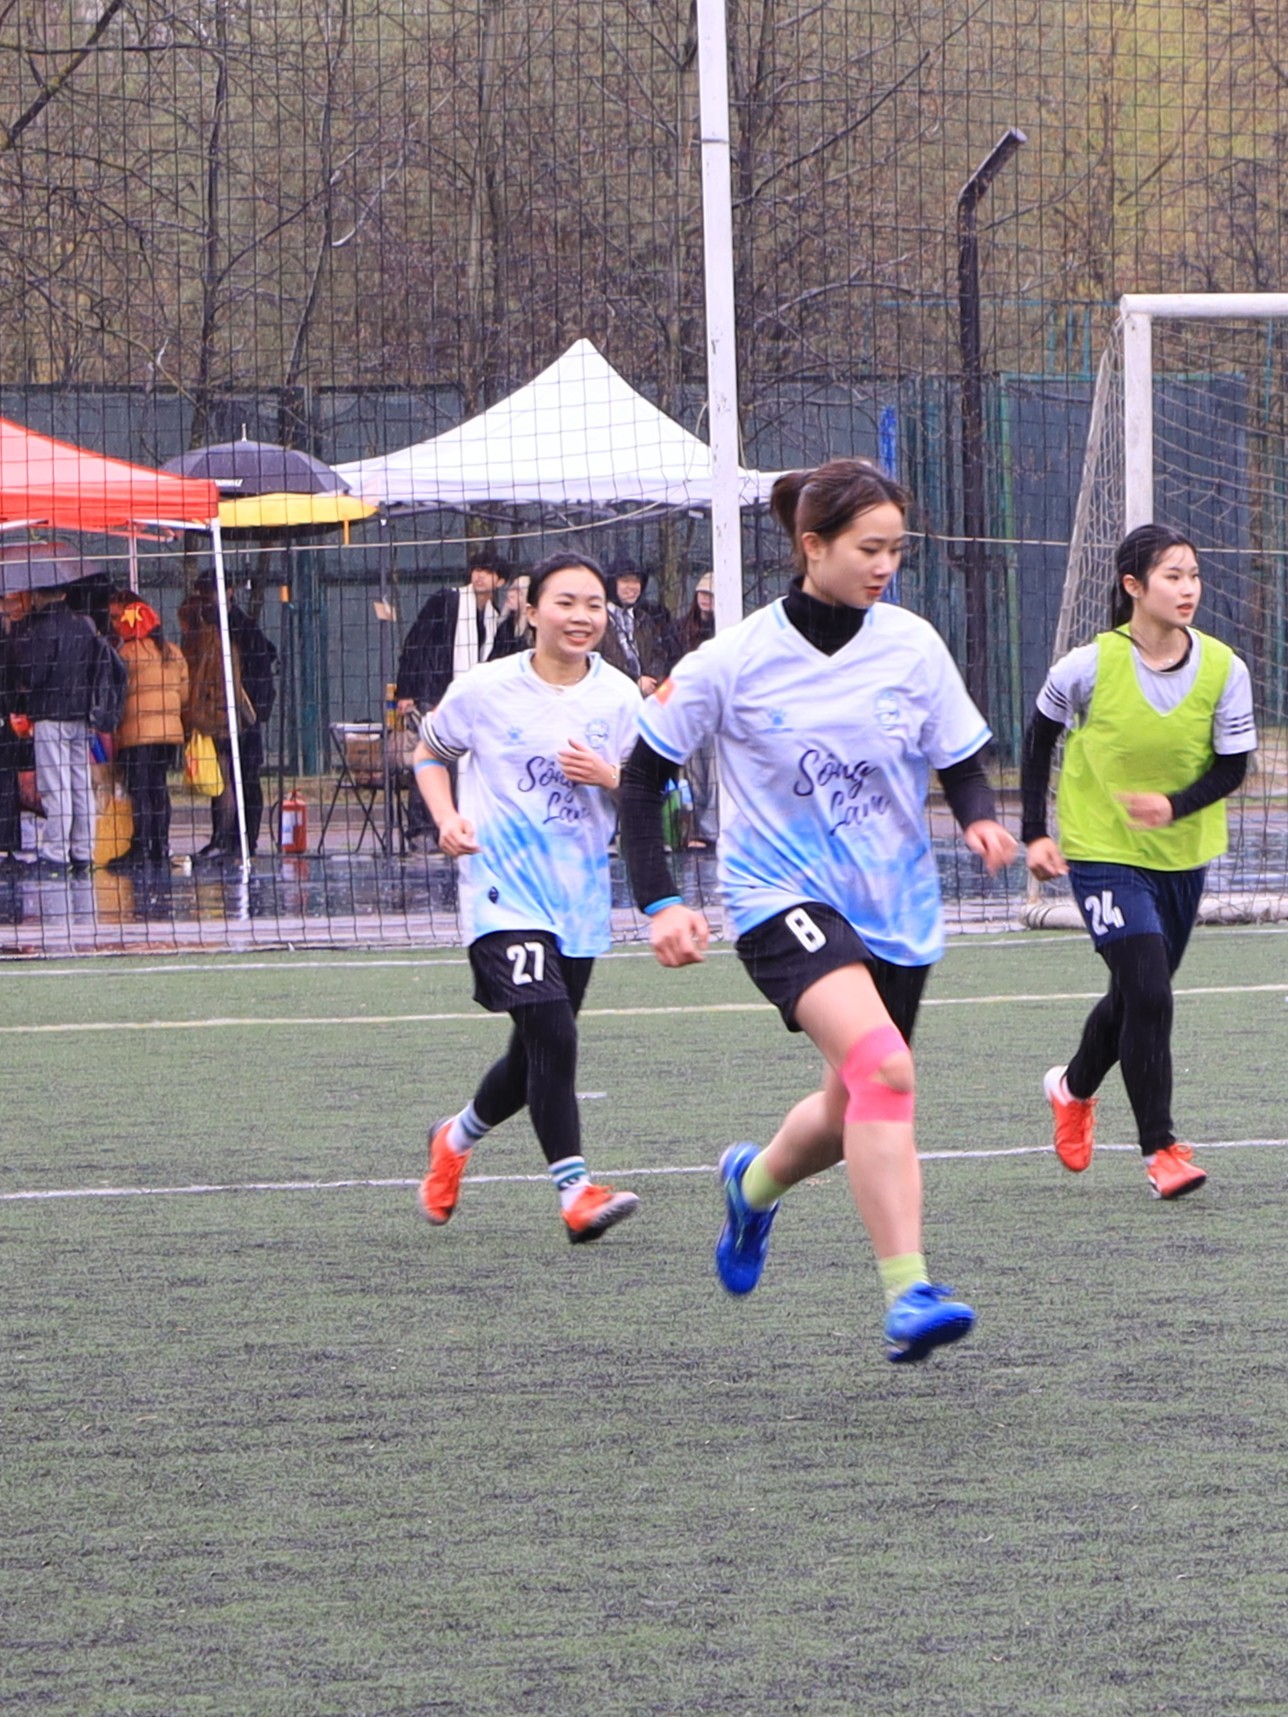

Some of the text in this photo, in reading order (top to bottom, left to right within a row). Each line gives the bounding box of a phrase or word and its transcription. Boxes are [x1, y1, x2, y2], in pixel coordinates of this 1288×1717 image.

[794, 749, 879, 799] Sông
[1085, 890, 1125, 936] 24
[506, 941, 544, 985] 27
